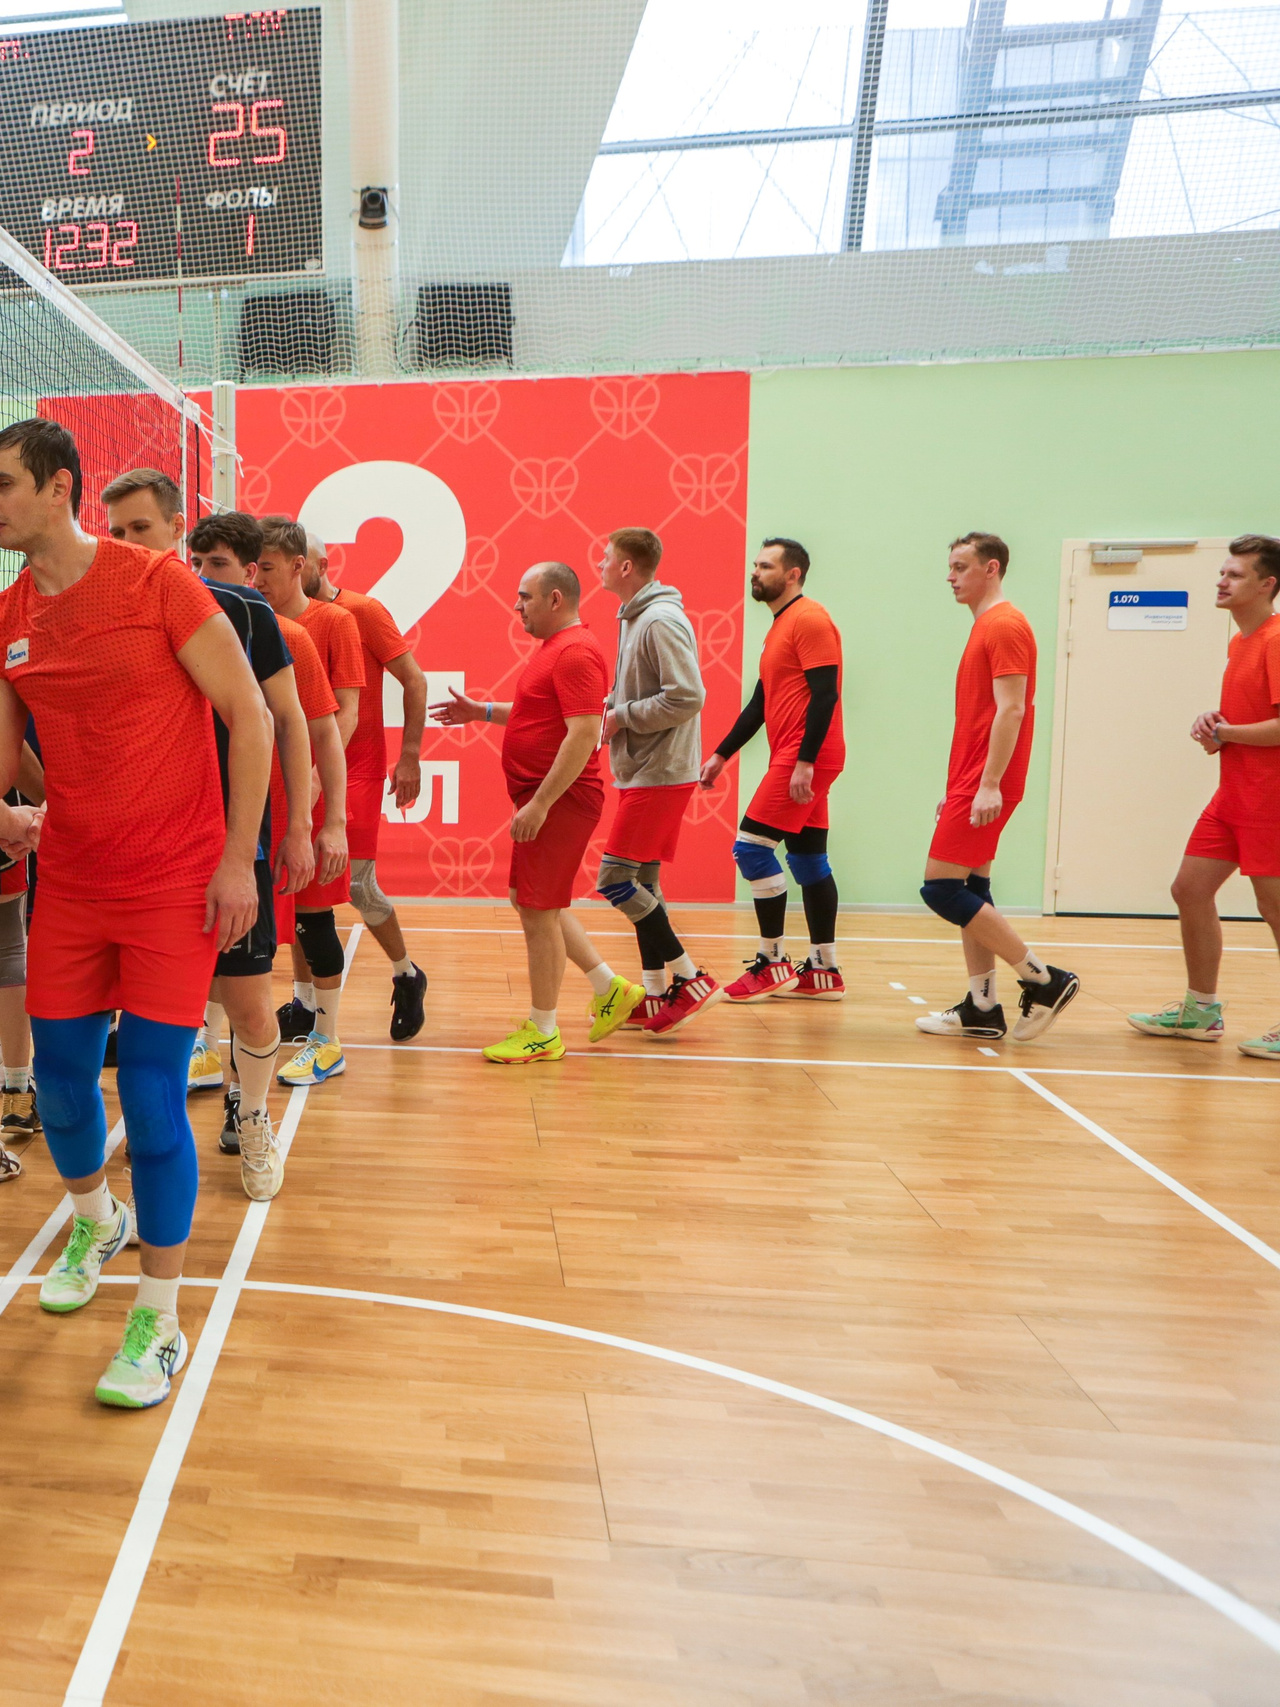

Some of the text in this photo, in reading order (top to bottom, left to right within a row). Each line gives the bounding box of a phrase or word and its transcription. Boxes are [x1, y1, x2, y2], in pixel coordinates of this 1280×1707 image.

[31, 97, 132, 126] ПЕРИОД
[209, 99, 286, 167] 25
[69, 130, 94, 175] 2
[41, 195, 125, 222] ВРЕМЯ
[205, 186, 278, 211] ФОЛЫ
[246, 213, 255, 256] 1
[1113, 594, 1140, 604] 1.070
